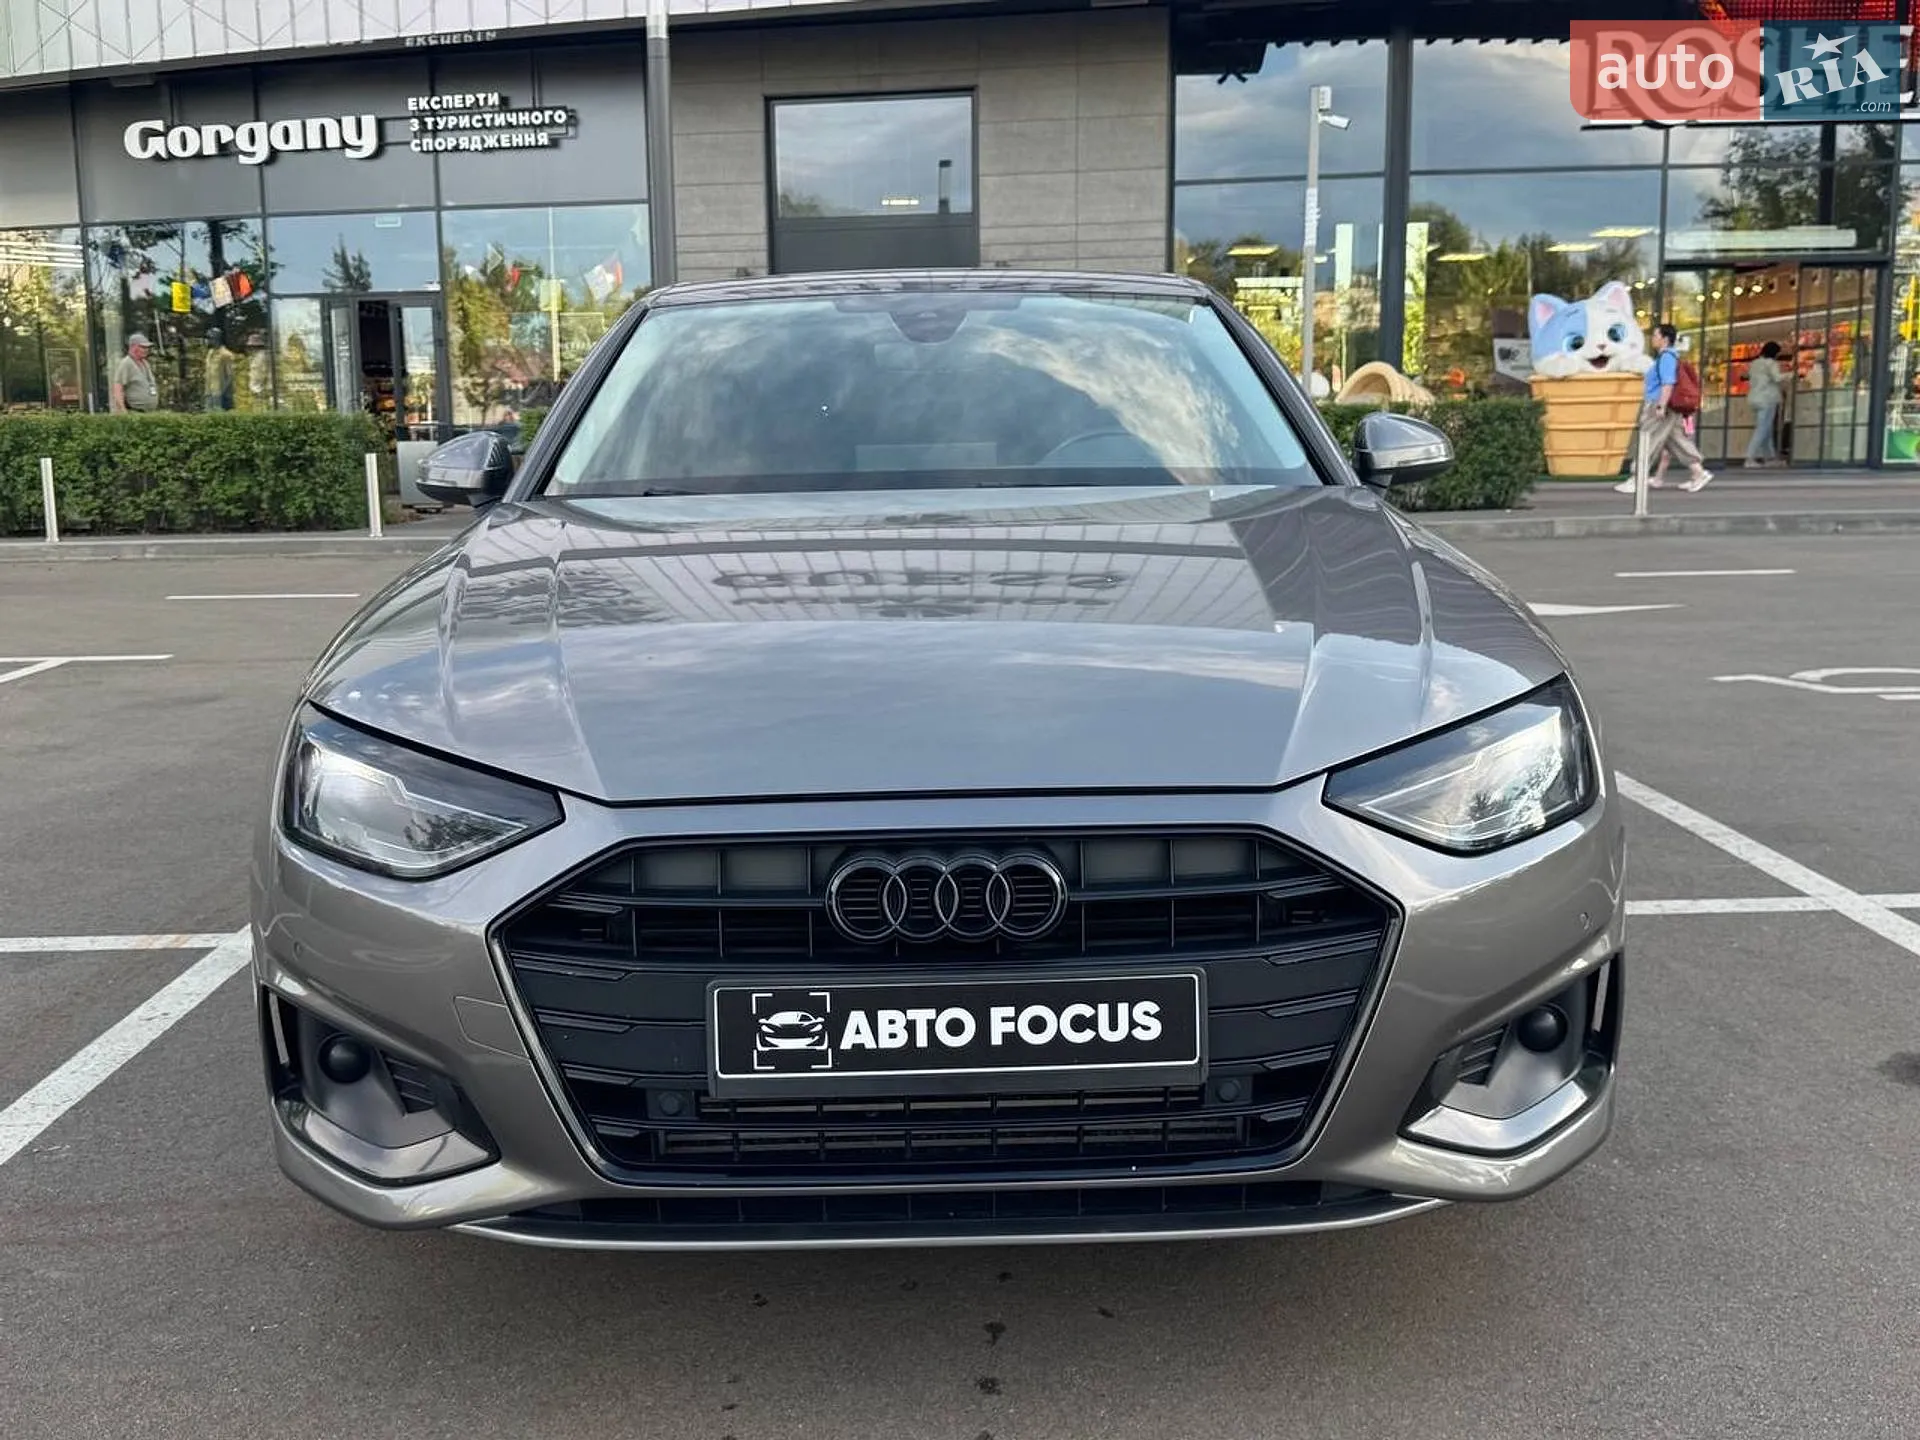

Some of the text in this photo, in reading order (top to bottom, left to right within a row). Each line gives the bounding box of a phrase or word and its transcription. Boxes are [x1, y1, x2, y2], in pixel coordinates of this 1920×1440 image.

[1593, 24, 1920, 124] ROSHE
[407, 92, 500, 111] ЕКСПЕРТИ
[426, 110, 567, 131] ТУРИСТИЧНОГО
[124, 114, 379, 165] Gorgany
[410, 132, 549, 152] СПОРЯДЖЕННЯ
[839, 1000, 1163, 1050] АВТО FOCUS
